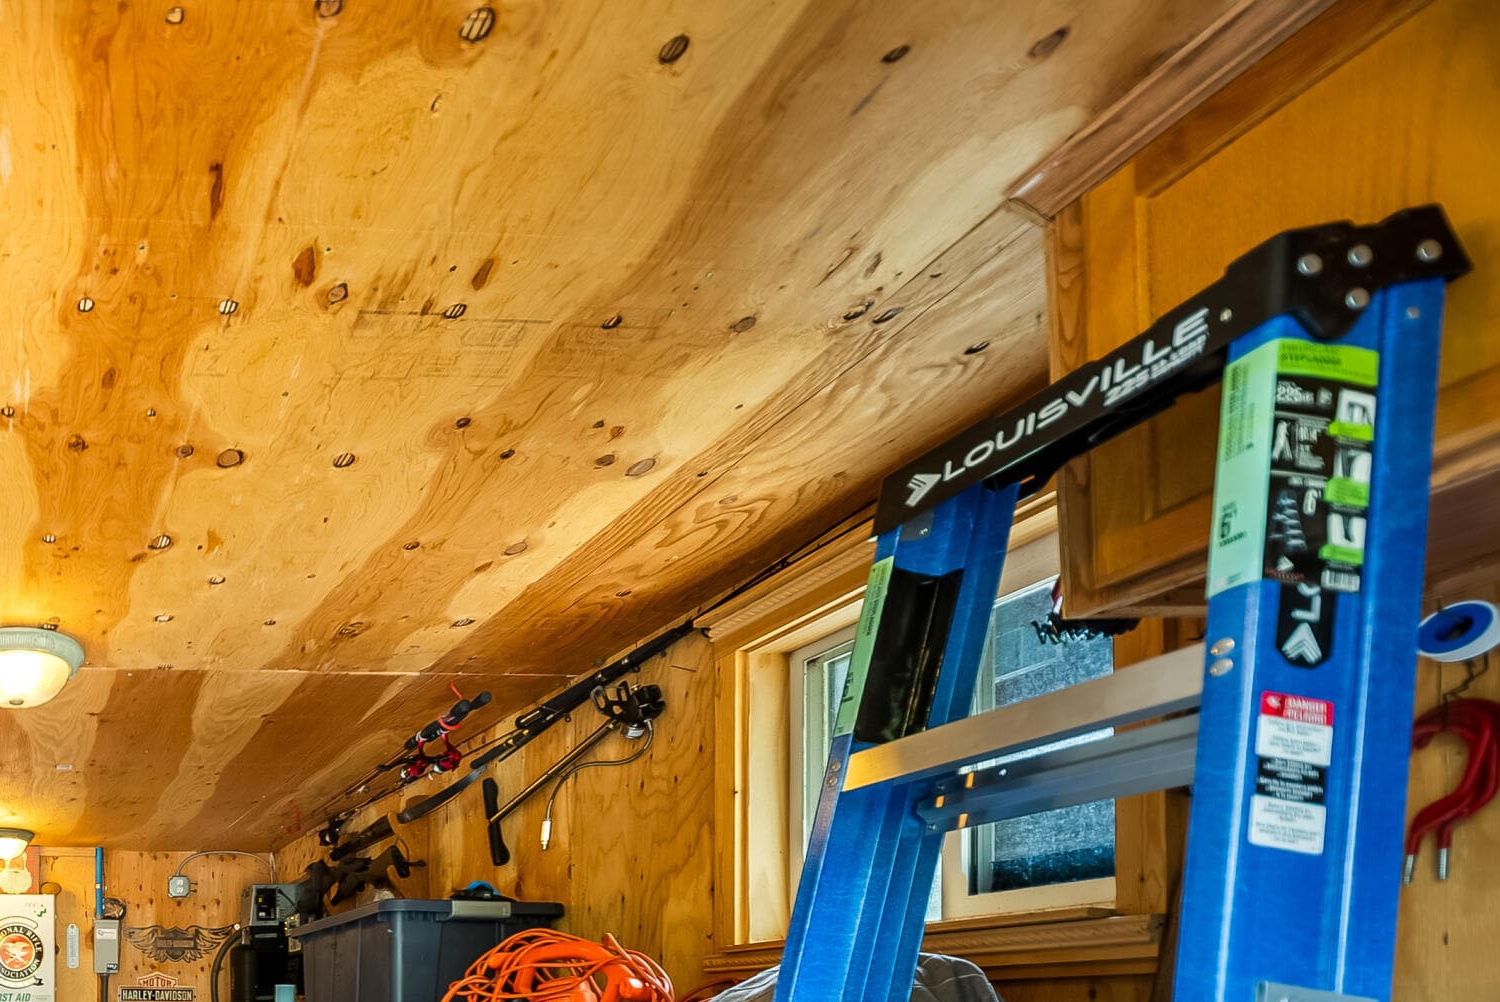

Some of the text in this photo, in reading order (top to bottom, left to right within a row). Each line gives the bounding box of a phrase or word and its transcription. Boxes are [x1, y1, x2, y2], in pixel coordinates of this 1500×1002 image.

[941, 306, 1210, 482] LOUISVILLE
[1103, 374, 1150, 407] 225
[142, 977, 172, 987] MOTOR
[15, 993, 31, 1002] AID
